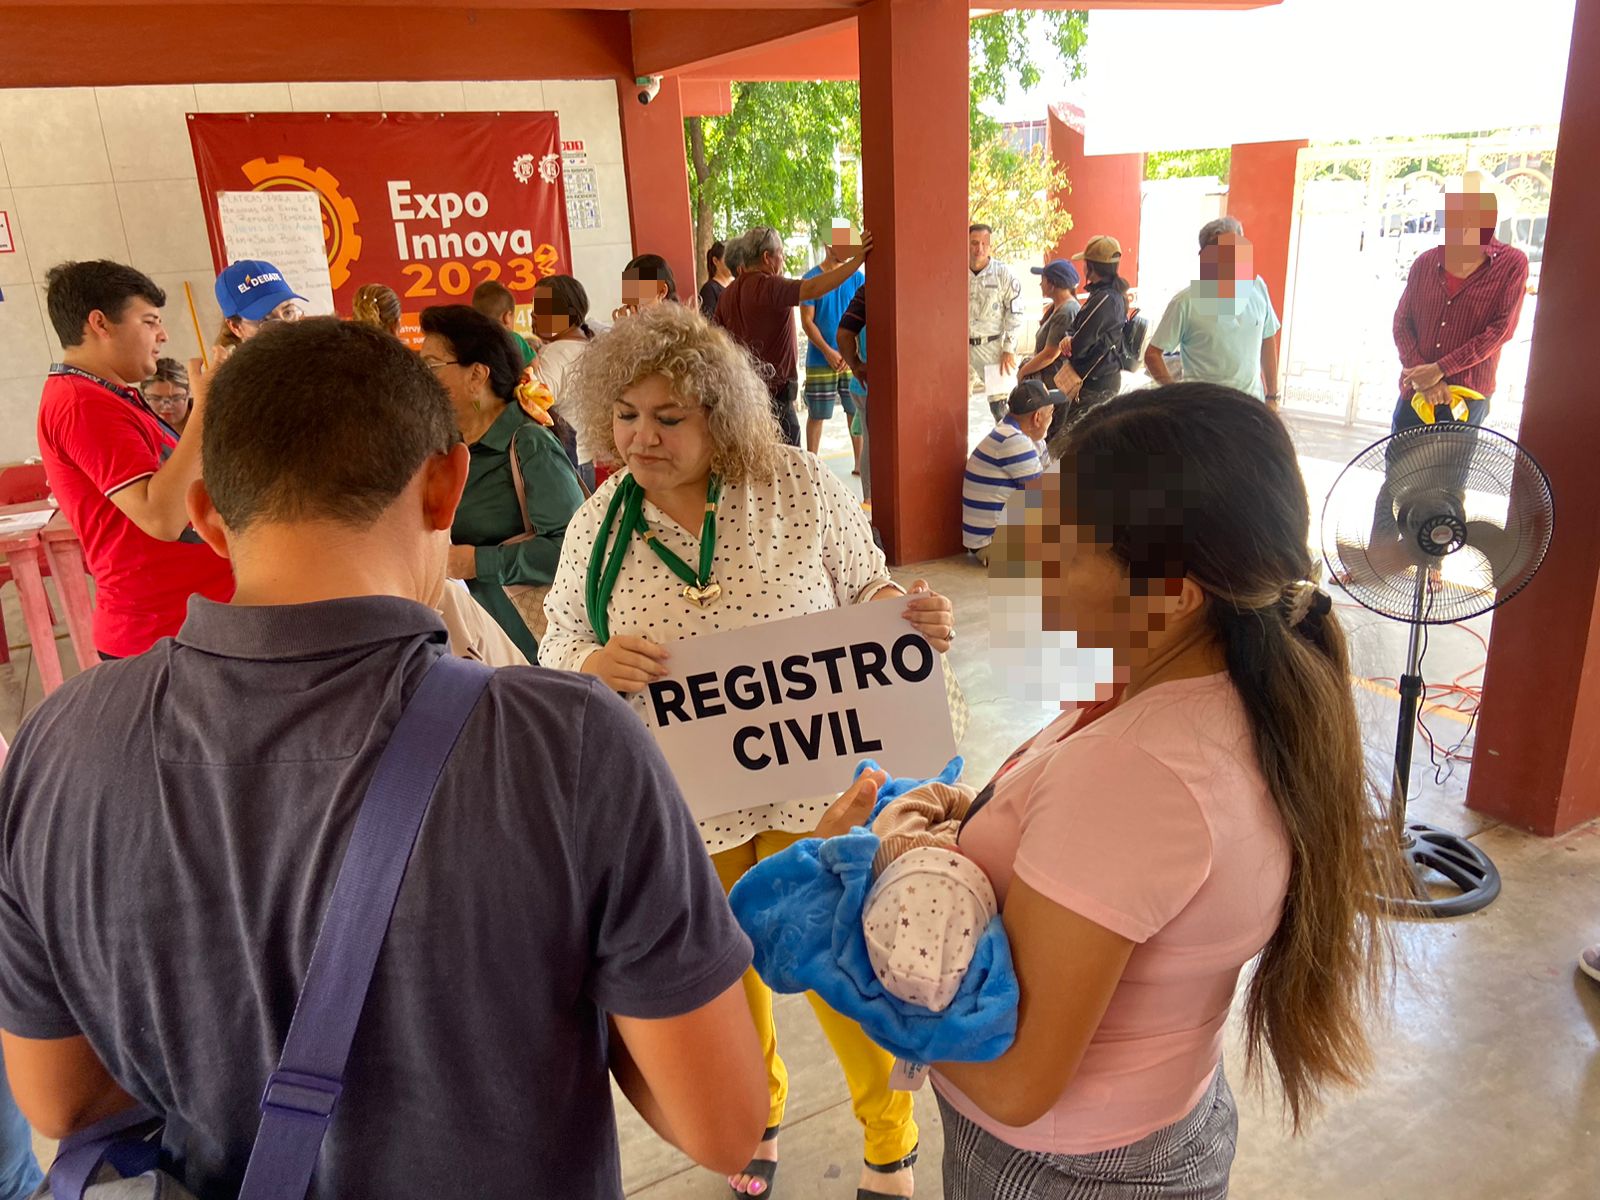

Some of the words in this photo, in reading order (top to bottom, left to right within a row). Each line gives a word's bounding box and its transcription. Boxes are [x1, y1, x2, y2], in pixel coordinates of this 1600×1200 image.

[387, 180, 489, 228] Expo
[394, 221, 534, 260] Innova
[237, 283, 251, 294] EL
[250, 272, 282, 287] DEBATE
[401, 257, 537, 298] 2023
[648, 633, 934, 727] REGISTRO
[732, 708, 883, 771] CIVIL
